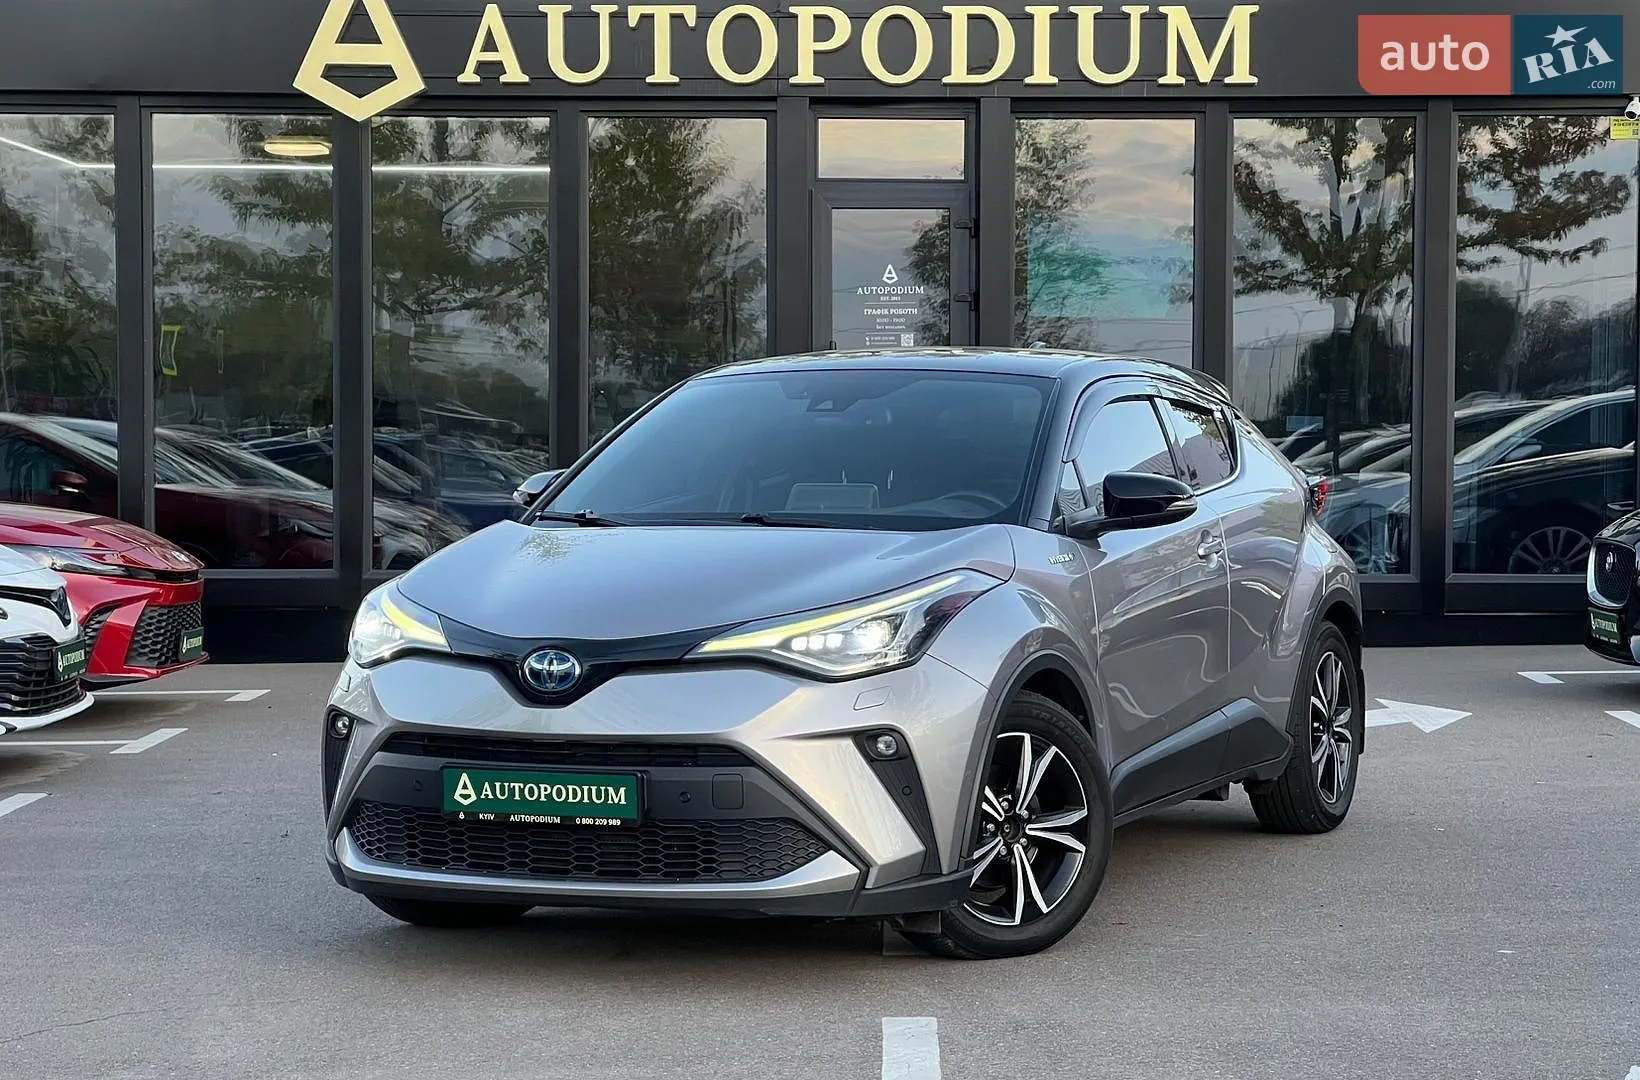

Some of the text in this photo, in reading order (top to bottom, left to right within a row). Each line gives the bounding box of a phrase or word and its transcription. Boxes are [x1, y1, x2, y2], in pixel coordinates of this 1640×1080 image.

[456, 3, 1260, 86] AUTOPODIUM
[856, 286, 924, 295] AUTOPODIUM
[480, 781, 627, 805] AUTOPODIUM
[479, 812, 495, 820] KYIV
[509, 814, 561, 824] AUTOPODIUM
